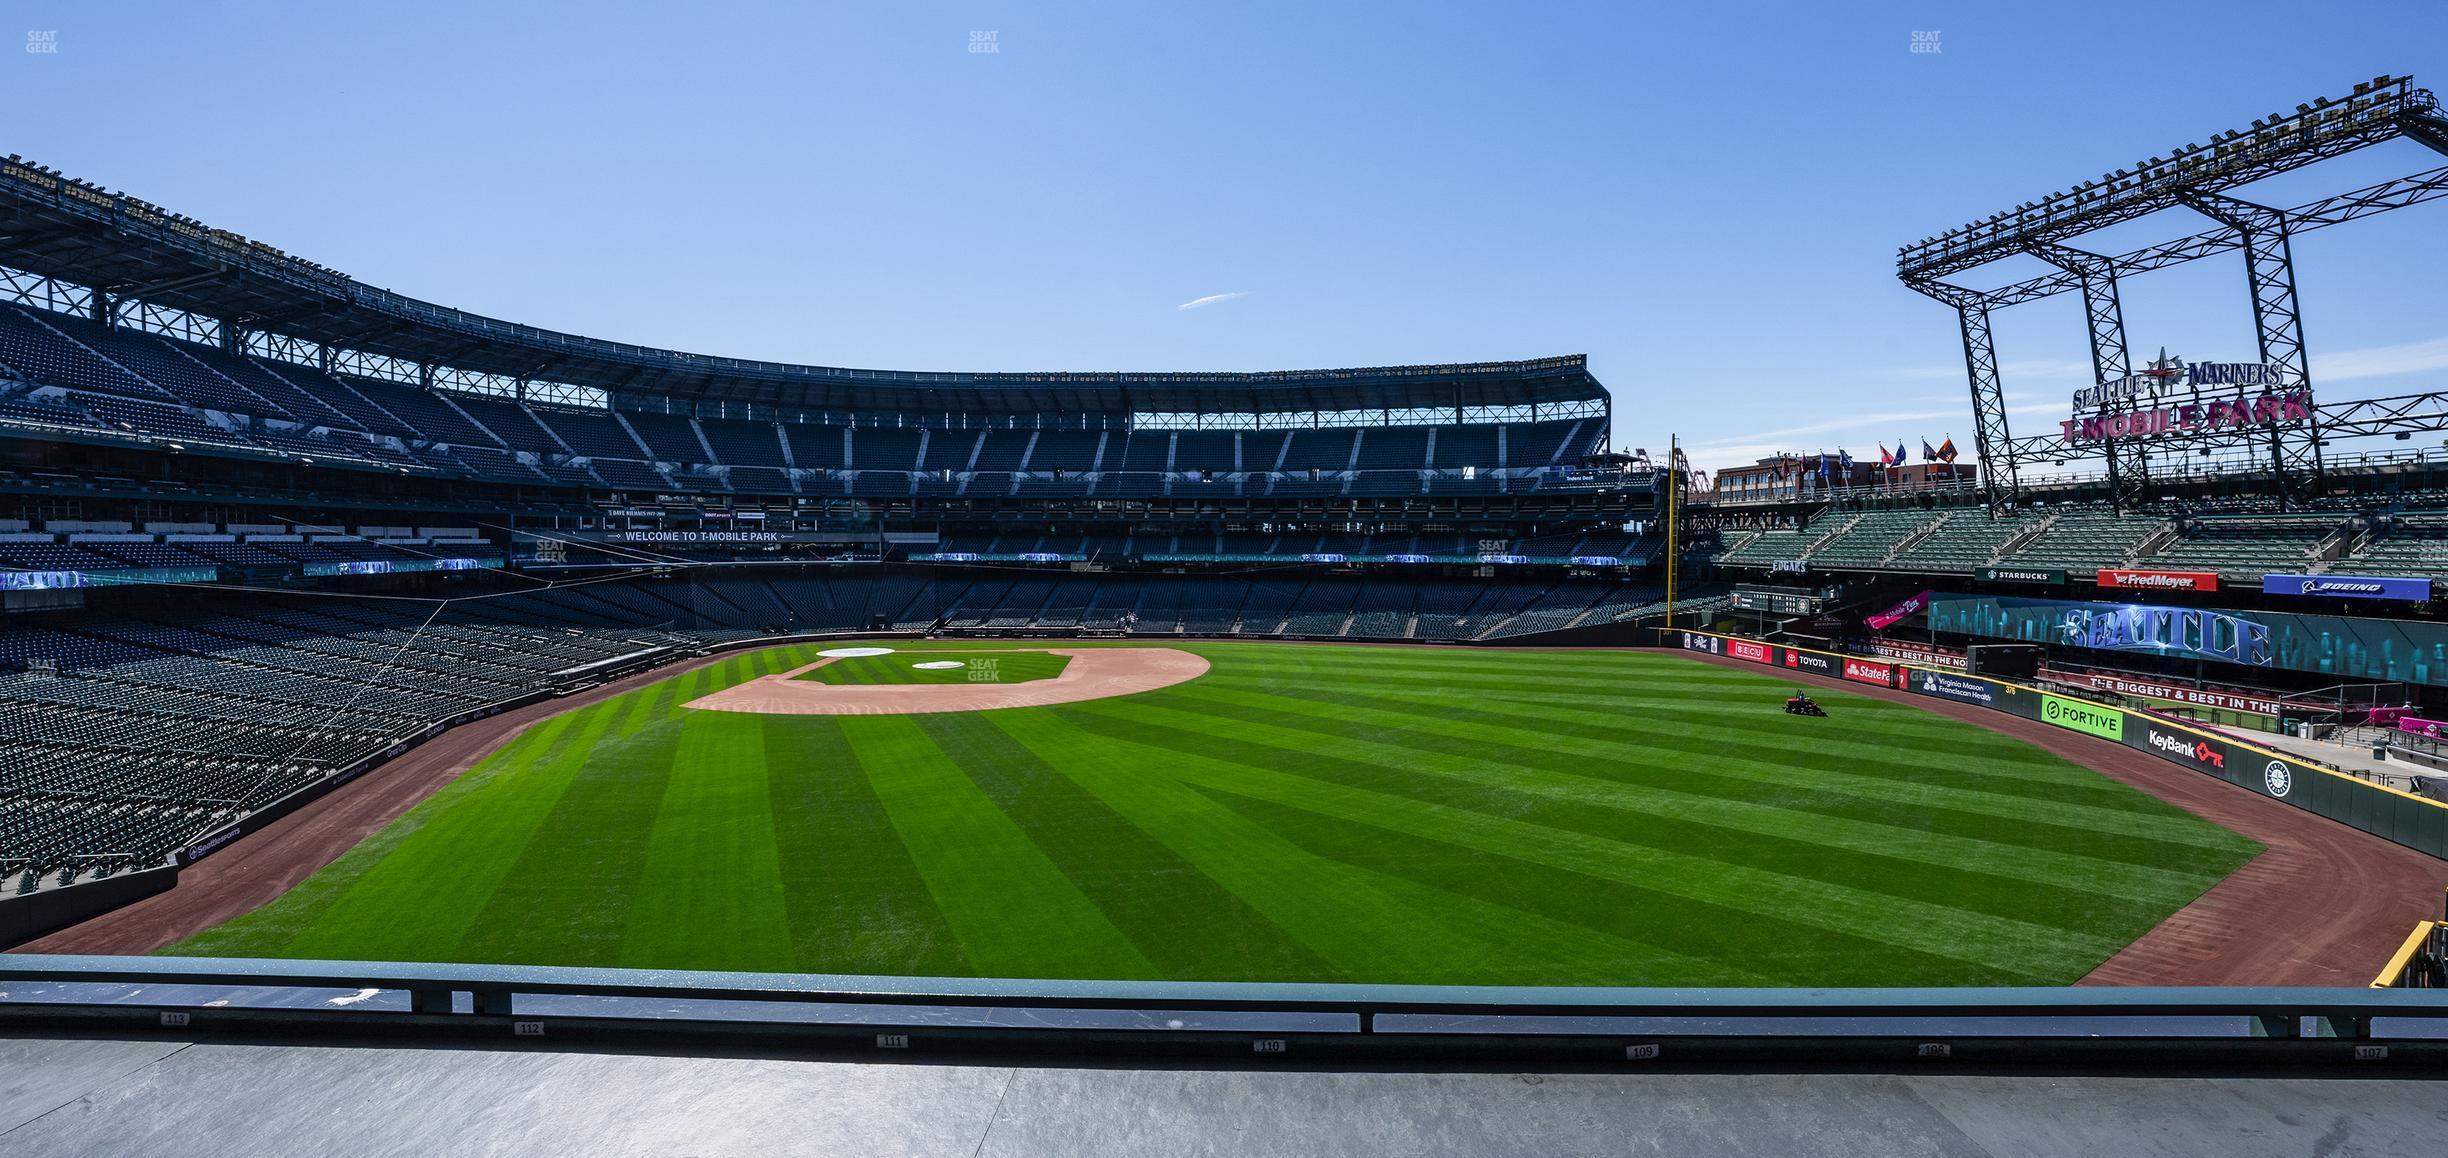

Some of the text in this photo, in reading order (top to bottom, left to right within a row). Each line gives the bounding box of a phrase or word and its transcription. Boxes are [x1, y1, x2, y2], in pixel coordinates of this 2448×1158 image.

[2072, 361, 2284, 411] SEATTLE MARINERS
[2060, 389, 2314, 443] T-MOBILE PARK
[625, 531, 778, 541] WELCOME TO T-MOBILE PARK
[1999, 572, 2048, 580] STARBUCKS
[2320, 583, 2381, 592] BOEING
[1737, 645, 1761, 657] BECU
[1848, 643, 1863, 652] THE
[1902, 651, 1922, 661] BEST
[1924, 654, 1933, 662] IN
[1934, 655, 1951, 665] THE
[1953, 658, 1968, 668] NO
[1799, 656, 1828, 668] TOYOTA
[1938, 677, 1984, 692] Virginia Mason
[2005, 685, 2016, 695] 376
[1938, 685, 1992, 701] Franciscan Health
[2090, 677, 2279, 713] THE BIGGEST & BEST IN THE
[2063, 707, 2117, 731] FORTIVE
[2149, 730, 2195, 758] KeyBank
[167, 1014, 185, 1024] 113
[521, 1023, 539, 1033] 112
[884, 1035, 901, 1046] 111
[1262, 1041, 1279, 1051] 110
[1634, 1046, 1653, 1057] 109
[2363, 1046, 2381, 1057] 107
